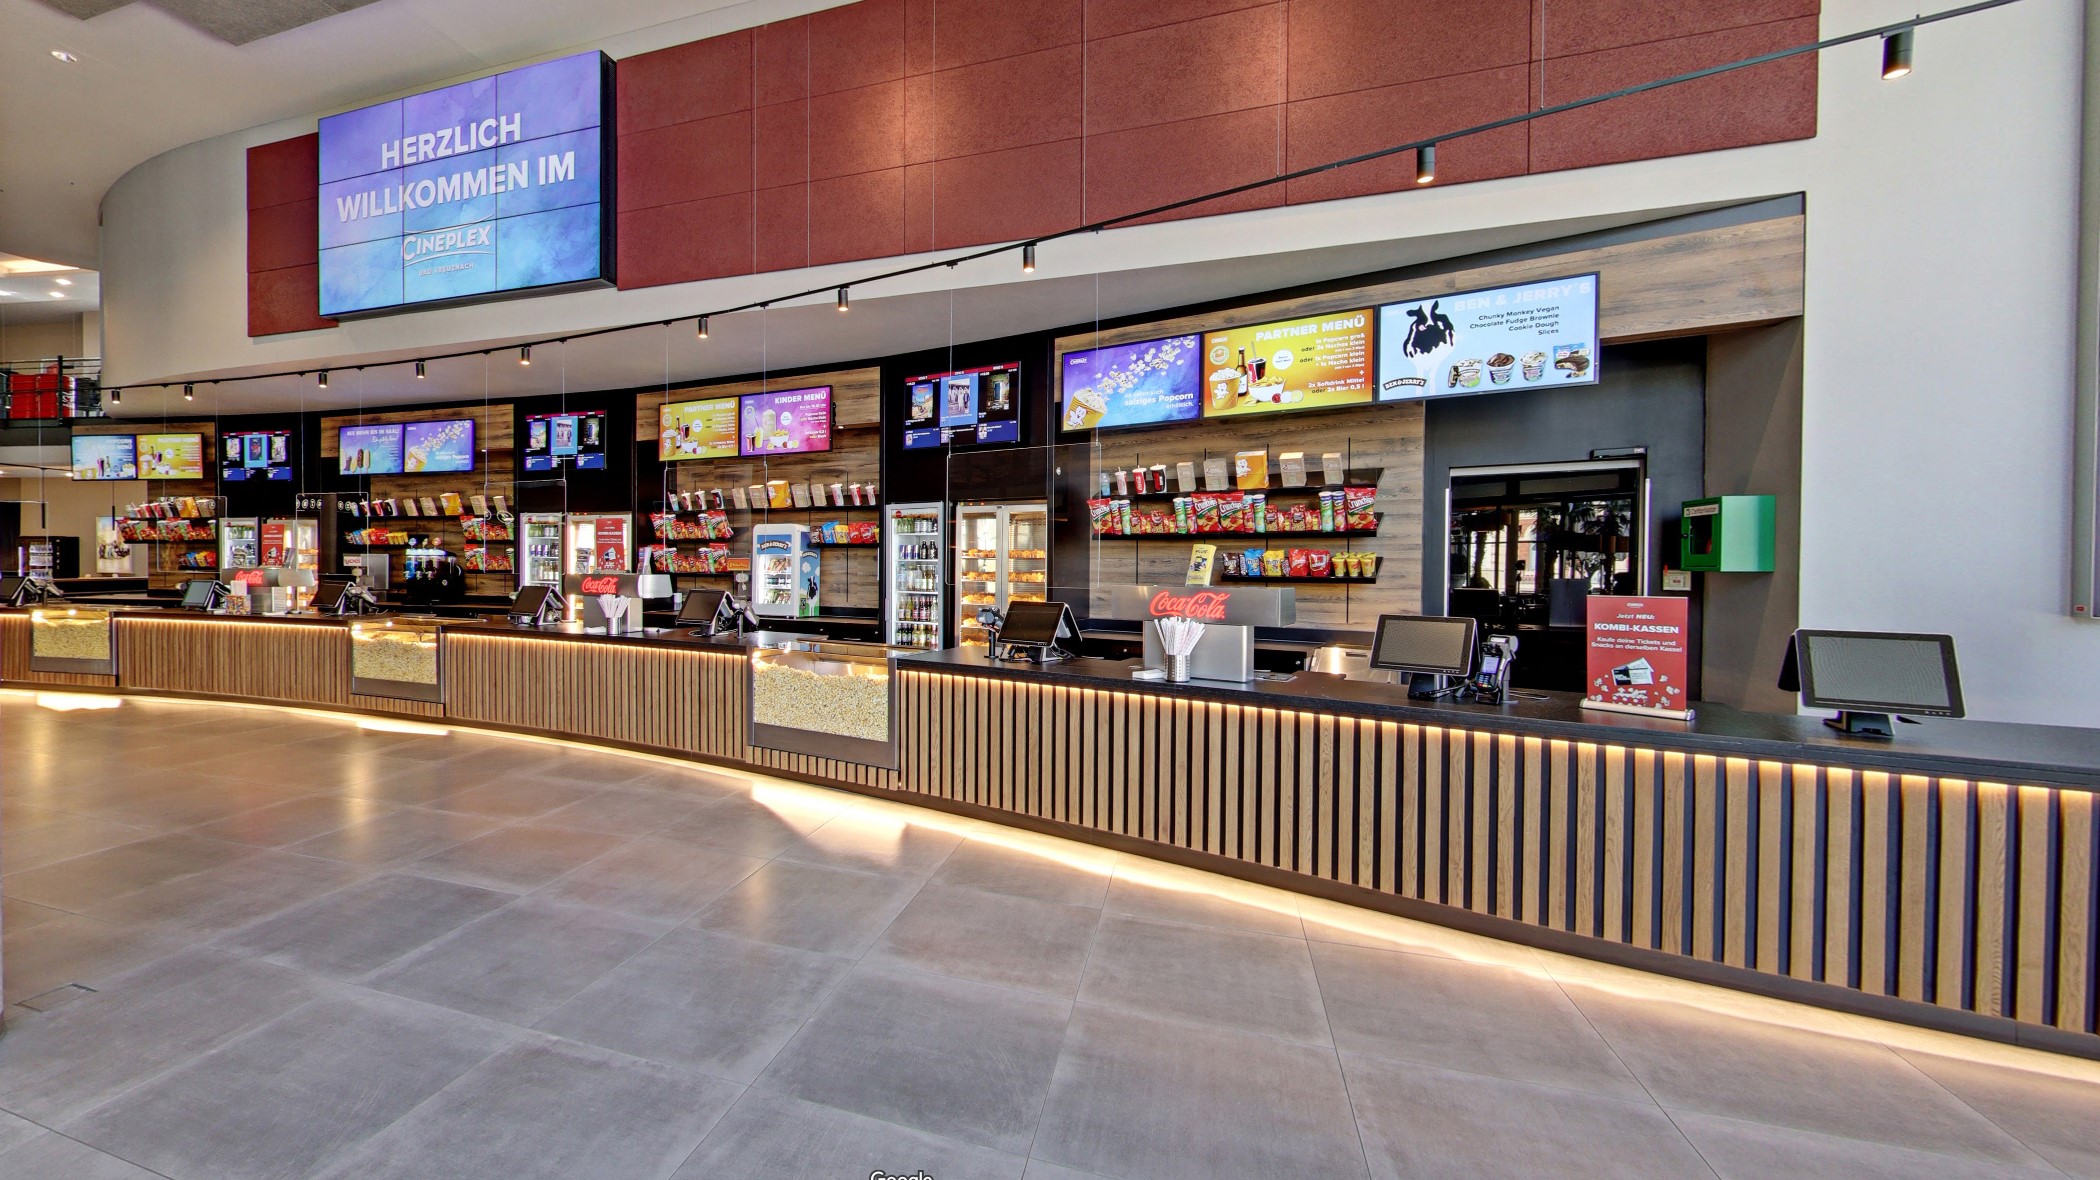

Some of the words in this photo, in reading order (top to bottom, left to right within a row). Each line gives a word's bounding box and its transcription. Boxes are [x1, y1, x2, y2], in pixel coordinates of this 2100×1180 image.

[381, 112, 521, 169] HERZLICH
[336, 160, 528, 223] WILLKOMMEN
[539, 151, 575, 186] IM
[403, 224, 492, 261] CINEPLEX
[1454, 296, 1490, 312] BEN
[1495, 294, 1508, 306] &
[1478, 312, 1505, 321] Chunky
[1506, 309, 1534, 317] Monkey
[1536, 305, 1559, 313] Vegan
[1470, 320, 1504, 329] Chocolate
[1506, 317, 1528, 325] Fudge
[1530, 313, 1559, 322] Brownie
[1509, 324, 1533, 332] Cookie
[1535, 321, 1559, 329] Dough
[1256, 324, 1318, 342] PARTNER
[1322, 315, 1365, 332] MENÜ
[1350, 333, 1365, 341] groß
[1317, 379, 1345, 387] Softdrink
[775, 395, 802, 404] KINDER
[804, 391, 826, 401] MENÜ
[1159, 393, 1194, 402] Popcorn
[684, 404, 714, 413] PARTNER
[581, 576, 619, 594] Coca-Cola
[1150, 590, 1231, 619] Coca-Cola
[1594, 622, 1679, 634] KOMBI-KASSEN
[1591, 641, 1614, 649] Snacks
[1625, 643, 1659, 651] derselben
[1637, 638, 1661, 646] Tickets
